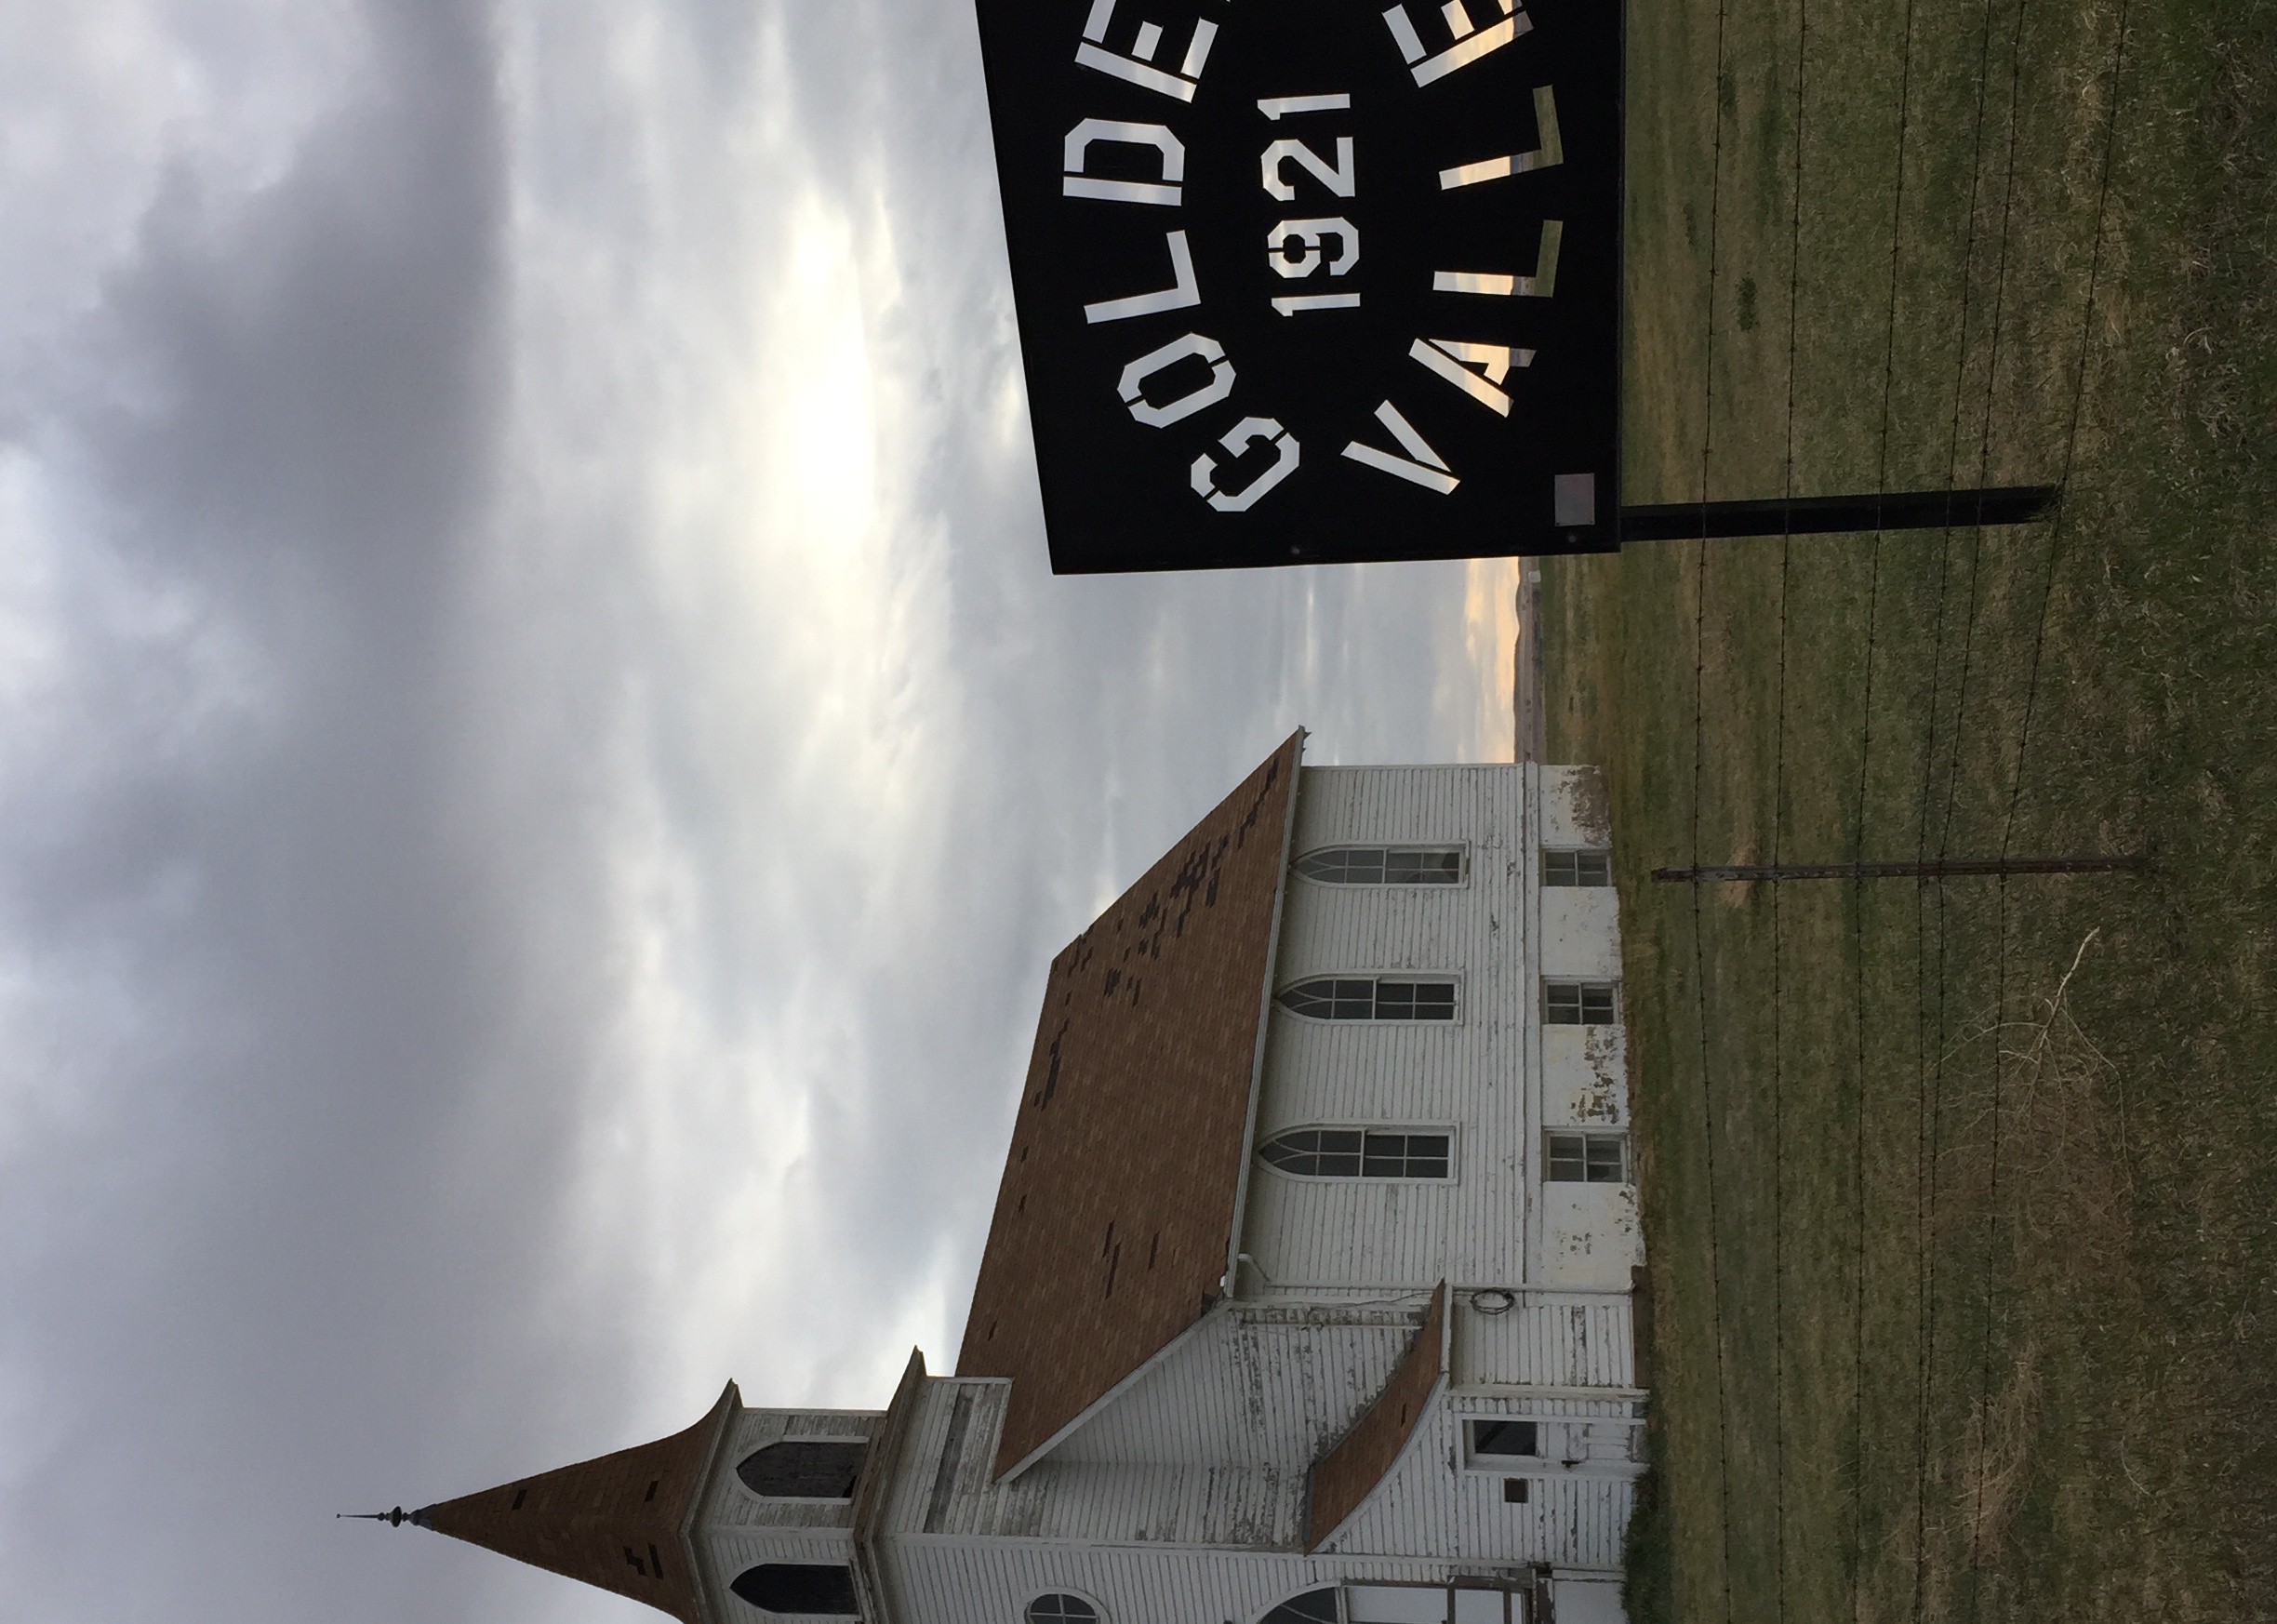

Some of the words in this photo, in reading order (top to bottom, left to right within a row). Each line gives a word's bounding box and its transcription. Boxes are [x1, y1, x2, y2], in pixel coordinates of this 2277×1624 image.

[1063, 0, 1299, 512] GOLDE
[1257, 93, 1360, 317] 1921
[1340, 0, 1564, 495] VALLE
